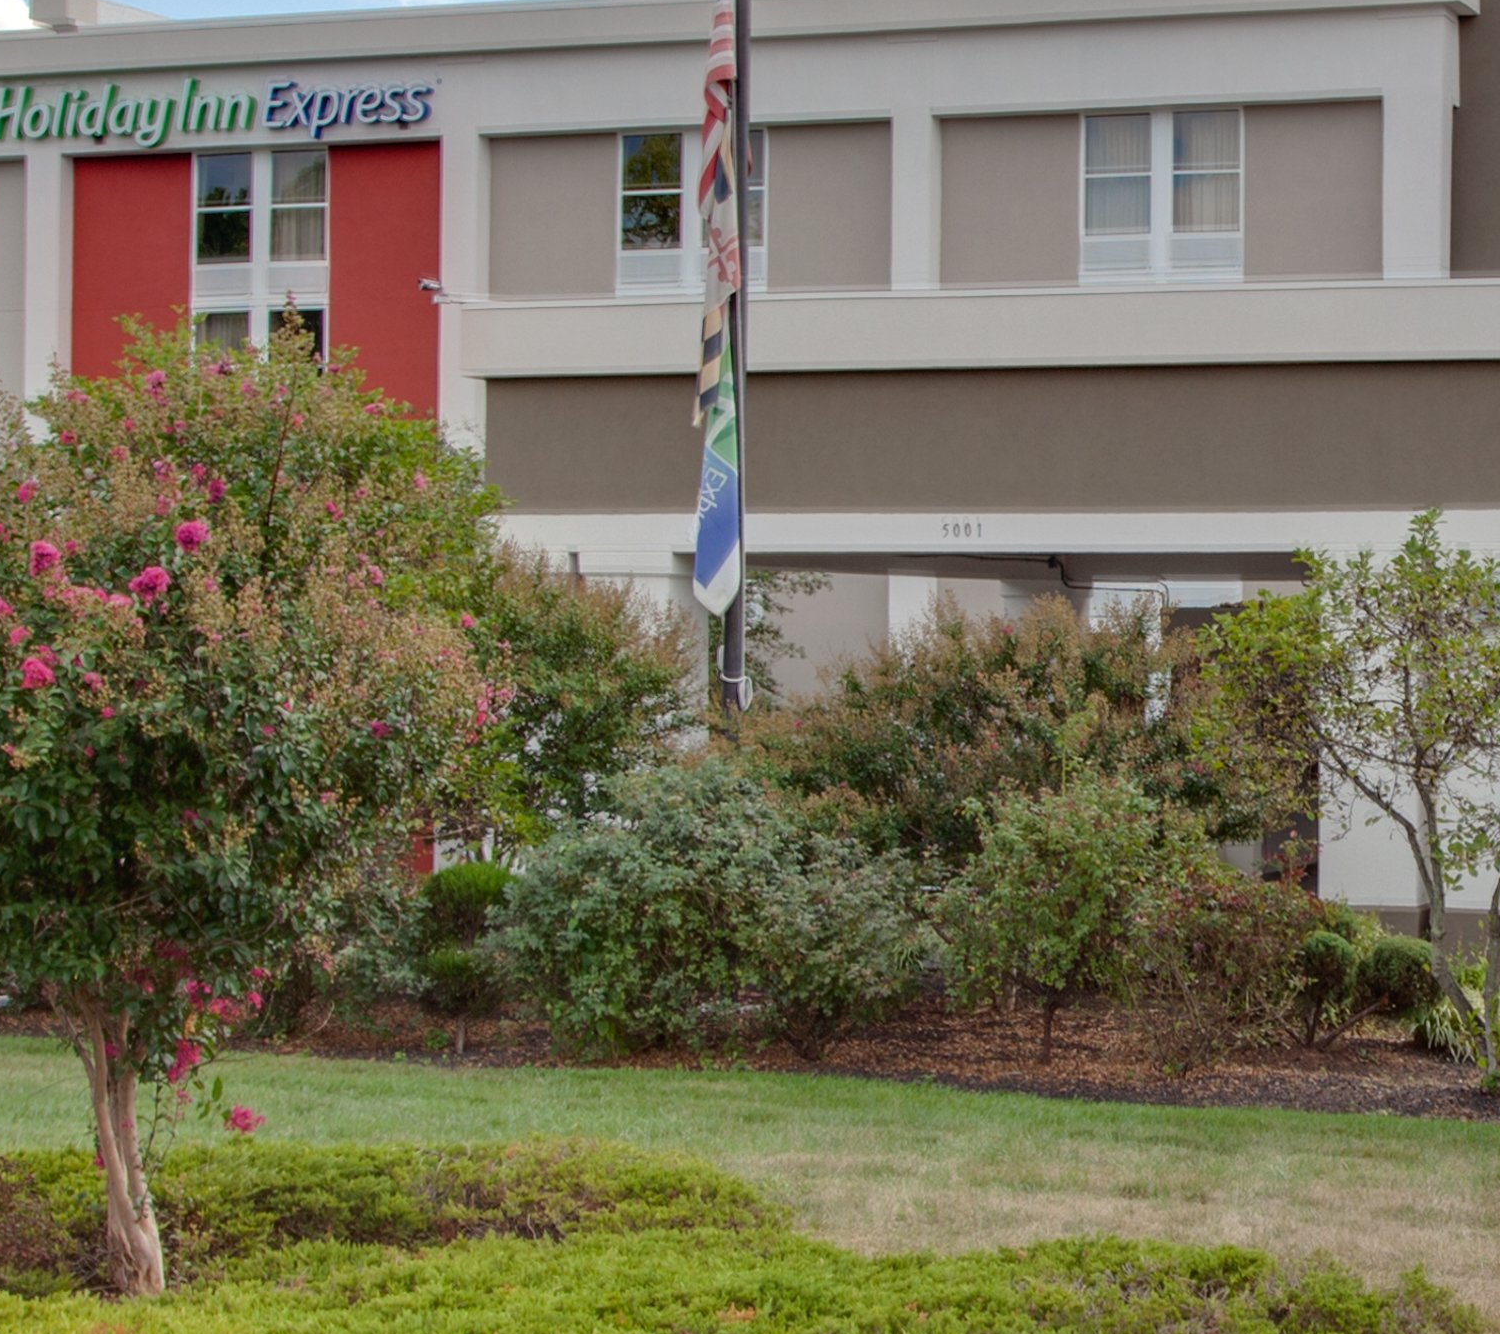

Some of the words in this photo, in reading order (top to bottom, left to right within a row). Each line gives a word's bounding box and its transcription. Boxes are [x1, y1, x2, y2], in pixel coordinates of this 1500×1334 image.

[177, 77, 257, 133] Inn
[262, 78, 434, 140] Express
[942, 522, 982, 538] 5001
